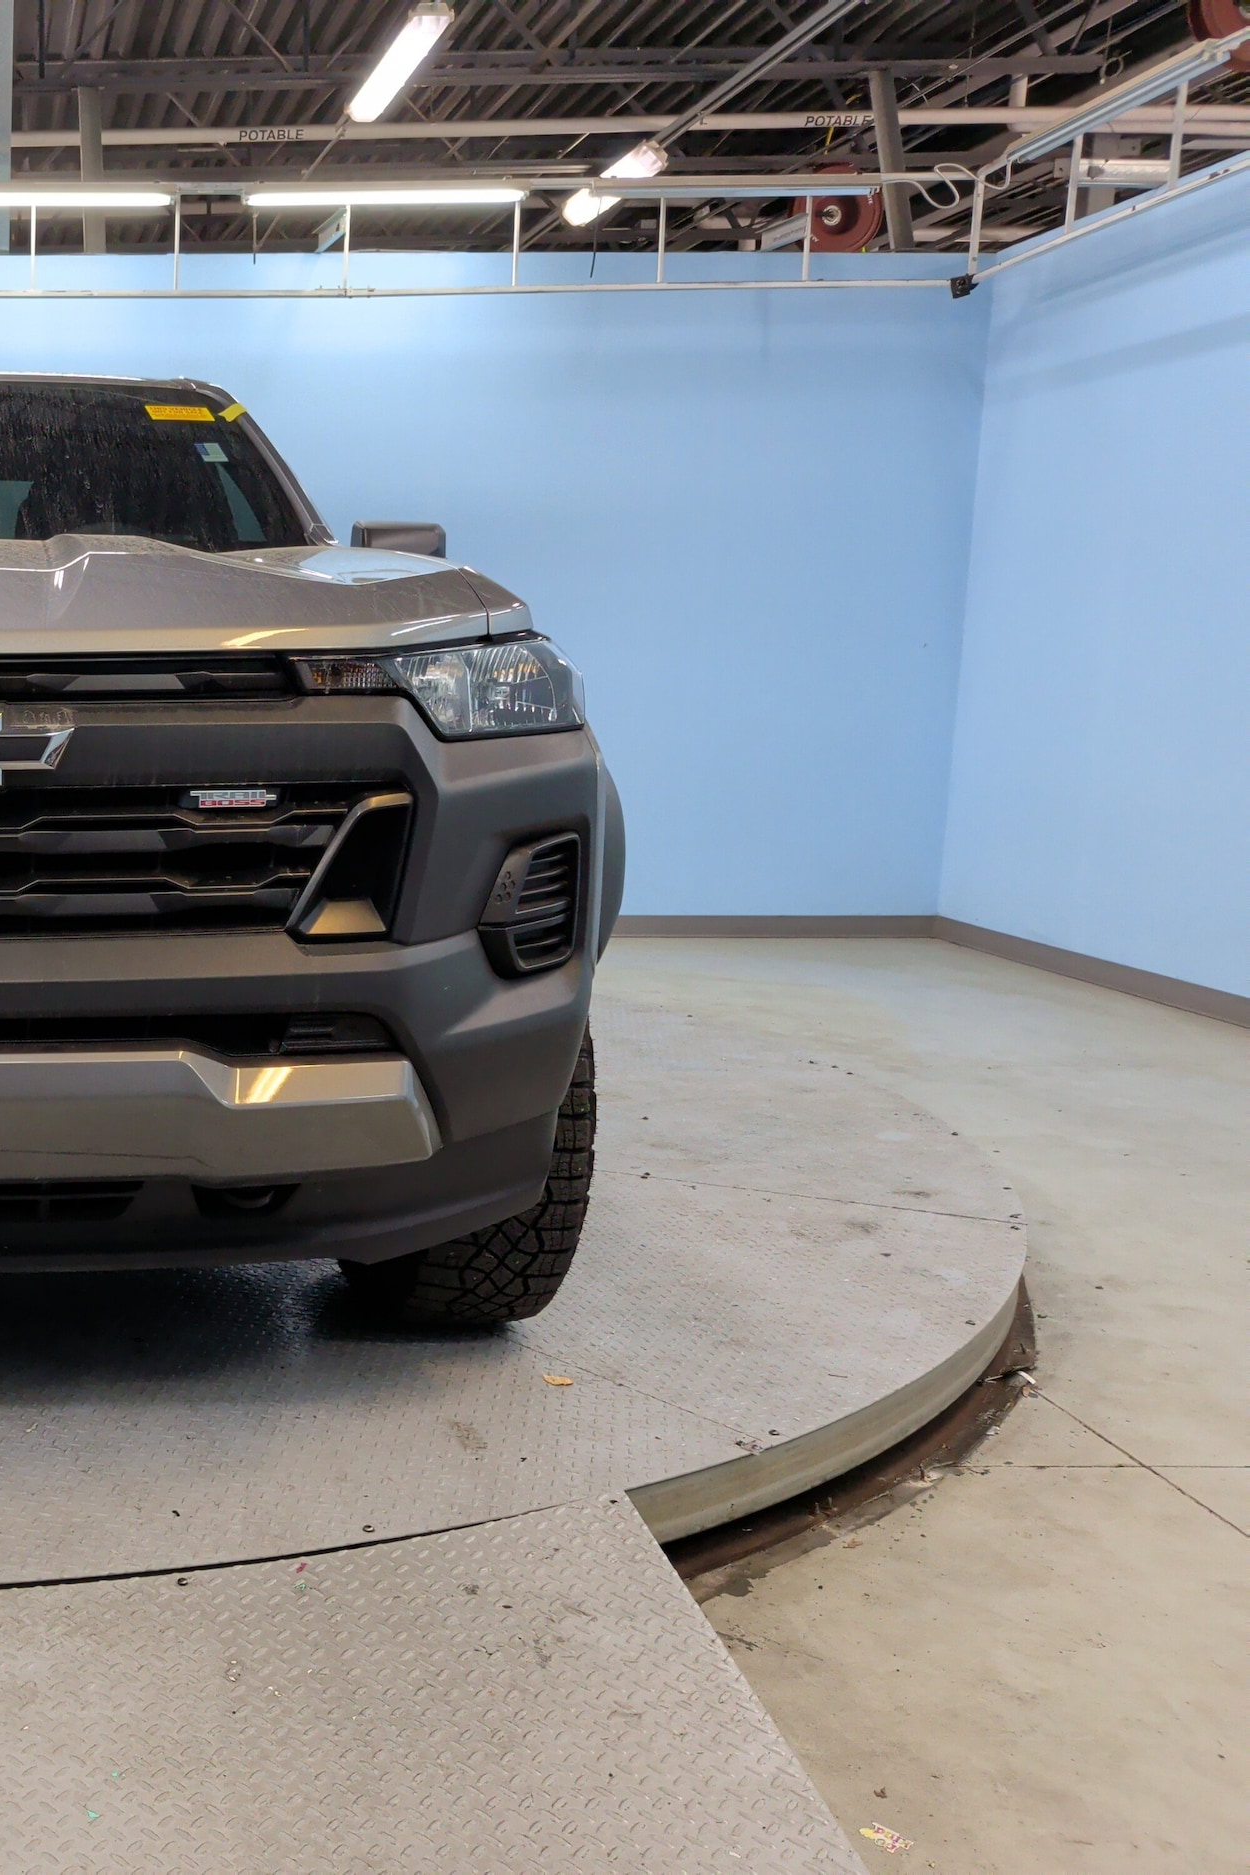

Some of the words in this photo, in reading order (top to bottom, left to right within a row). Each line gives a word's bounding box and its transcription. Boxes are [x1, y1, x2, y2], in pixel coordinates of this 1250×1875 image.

[805, 115, 872, 127] POTABLE
[239, 129, 304, 141] POTABLE
[190, 790, 277, 800] TRAIL
[200, 799, 267, 808] BOSS
